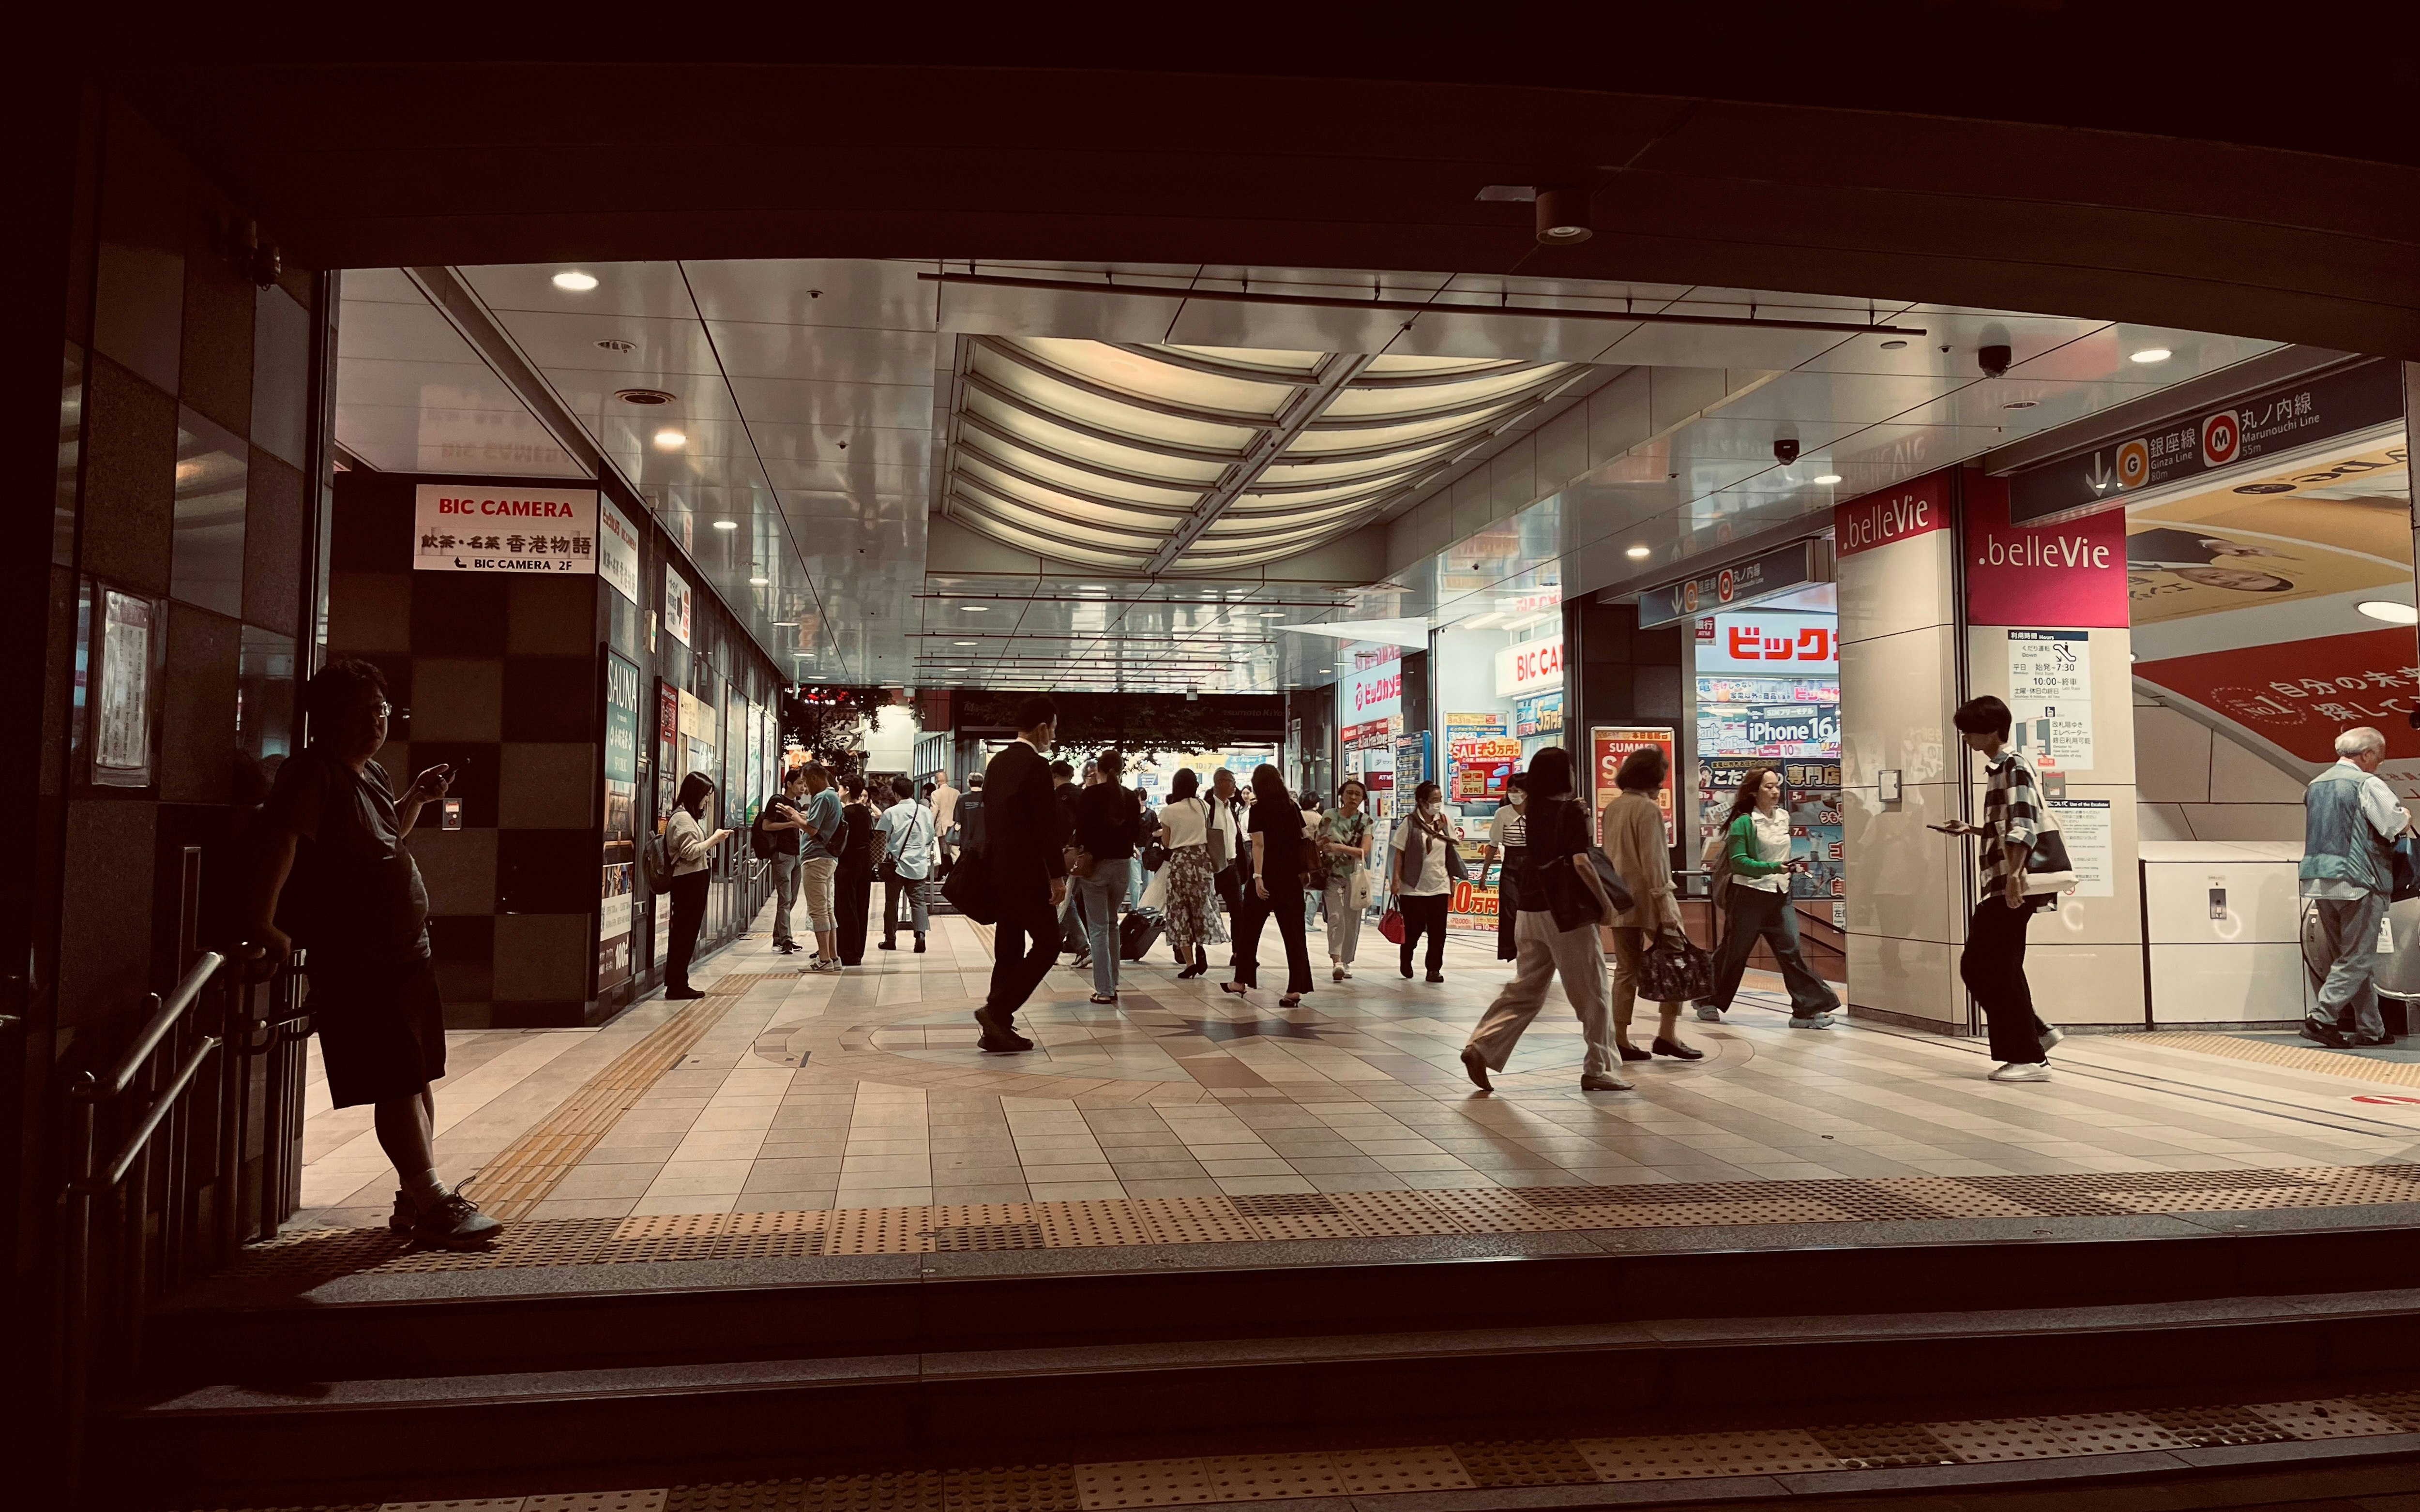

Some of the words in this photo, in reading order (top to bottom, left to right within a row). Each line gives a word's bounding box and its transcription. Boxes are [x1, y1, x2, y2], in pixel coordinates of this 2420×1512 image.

[2241, 392, 2312, 431] 丸ノ内線
[2242, 419, 2297, 443] Marunouchi
[2300, 414, 2320, 427] Line
[2150, 428, 2196, 458] 銀座線
[2242, 443, 2262, 456] 55m
[2151, 456, 2174, 470] Ginza
[2176, 450, 2193, 463] Line
[2151, 471, 2168, 482] 80m
[439, 498, 474, 514] BIC
[481, 500, 574, 517] CAMERA
[506, 535, 591, 554] 香港物語
[474, 559, 495, 569] BIC
[498, 560, 551, 570] CAMERA
[559, 561, 572, 570] 2F
[1729, 627, 1839, 660] ビック
[1517, 652, 1536, 681] BIC
[1540, 644, 1564, 675] CA
[607, 659, 637, 713] SAUNA
[1453, 744, 1483, 759] SALE
[1487, 741, 1514, 756] 3万円
